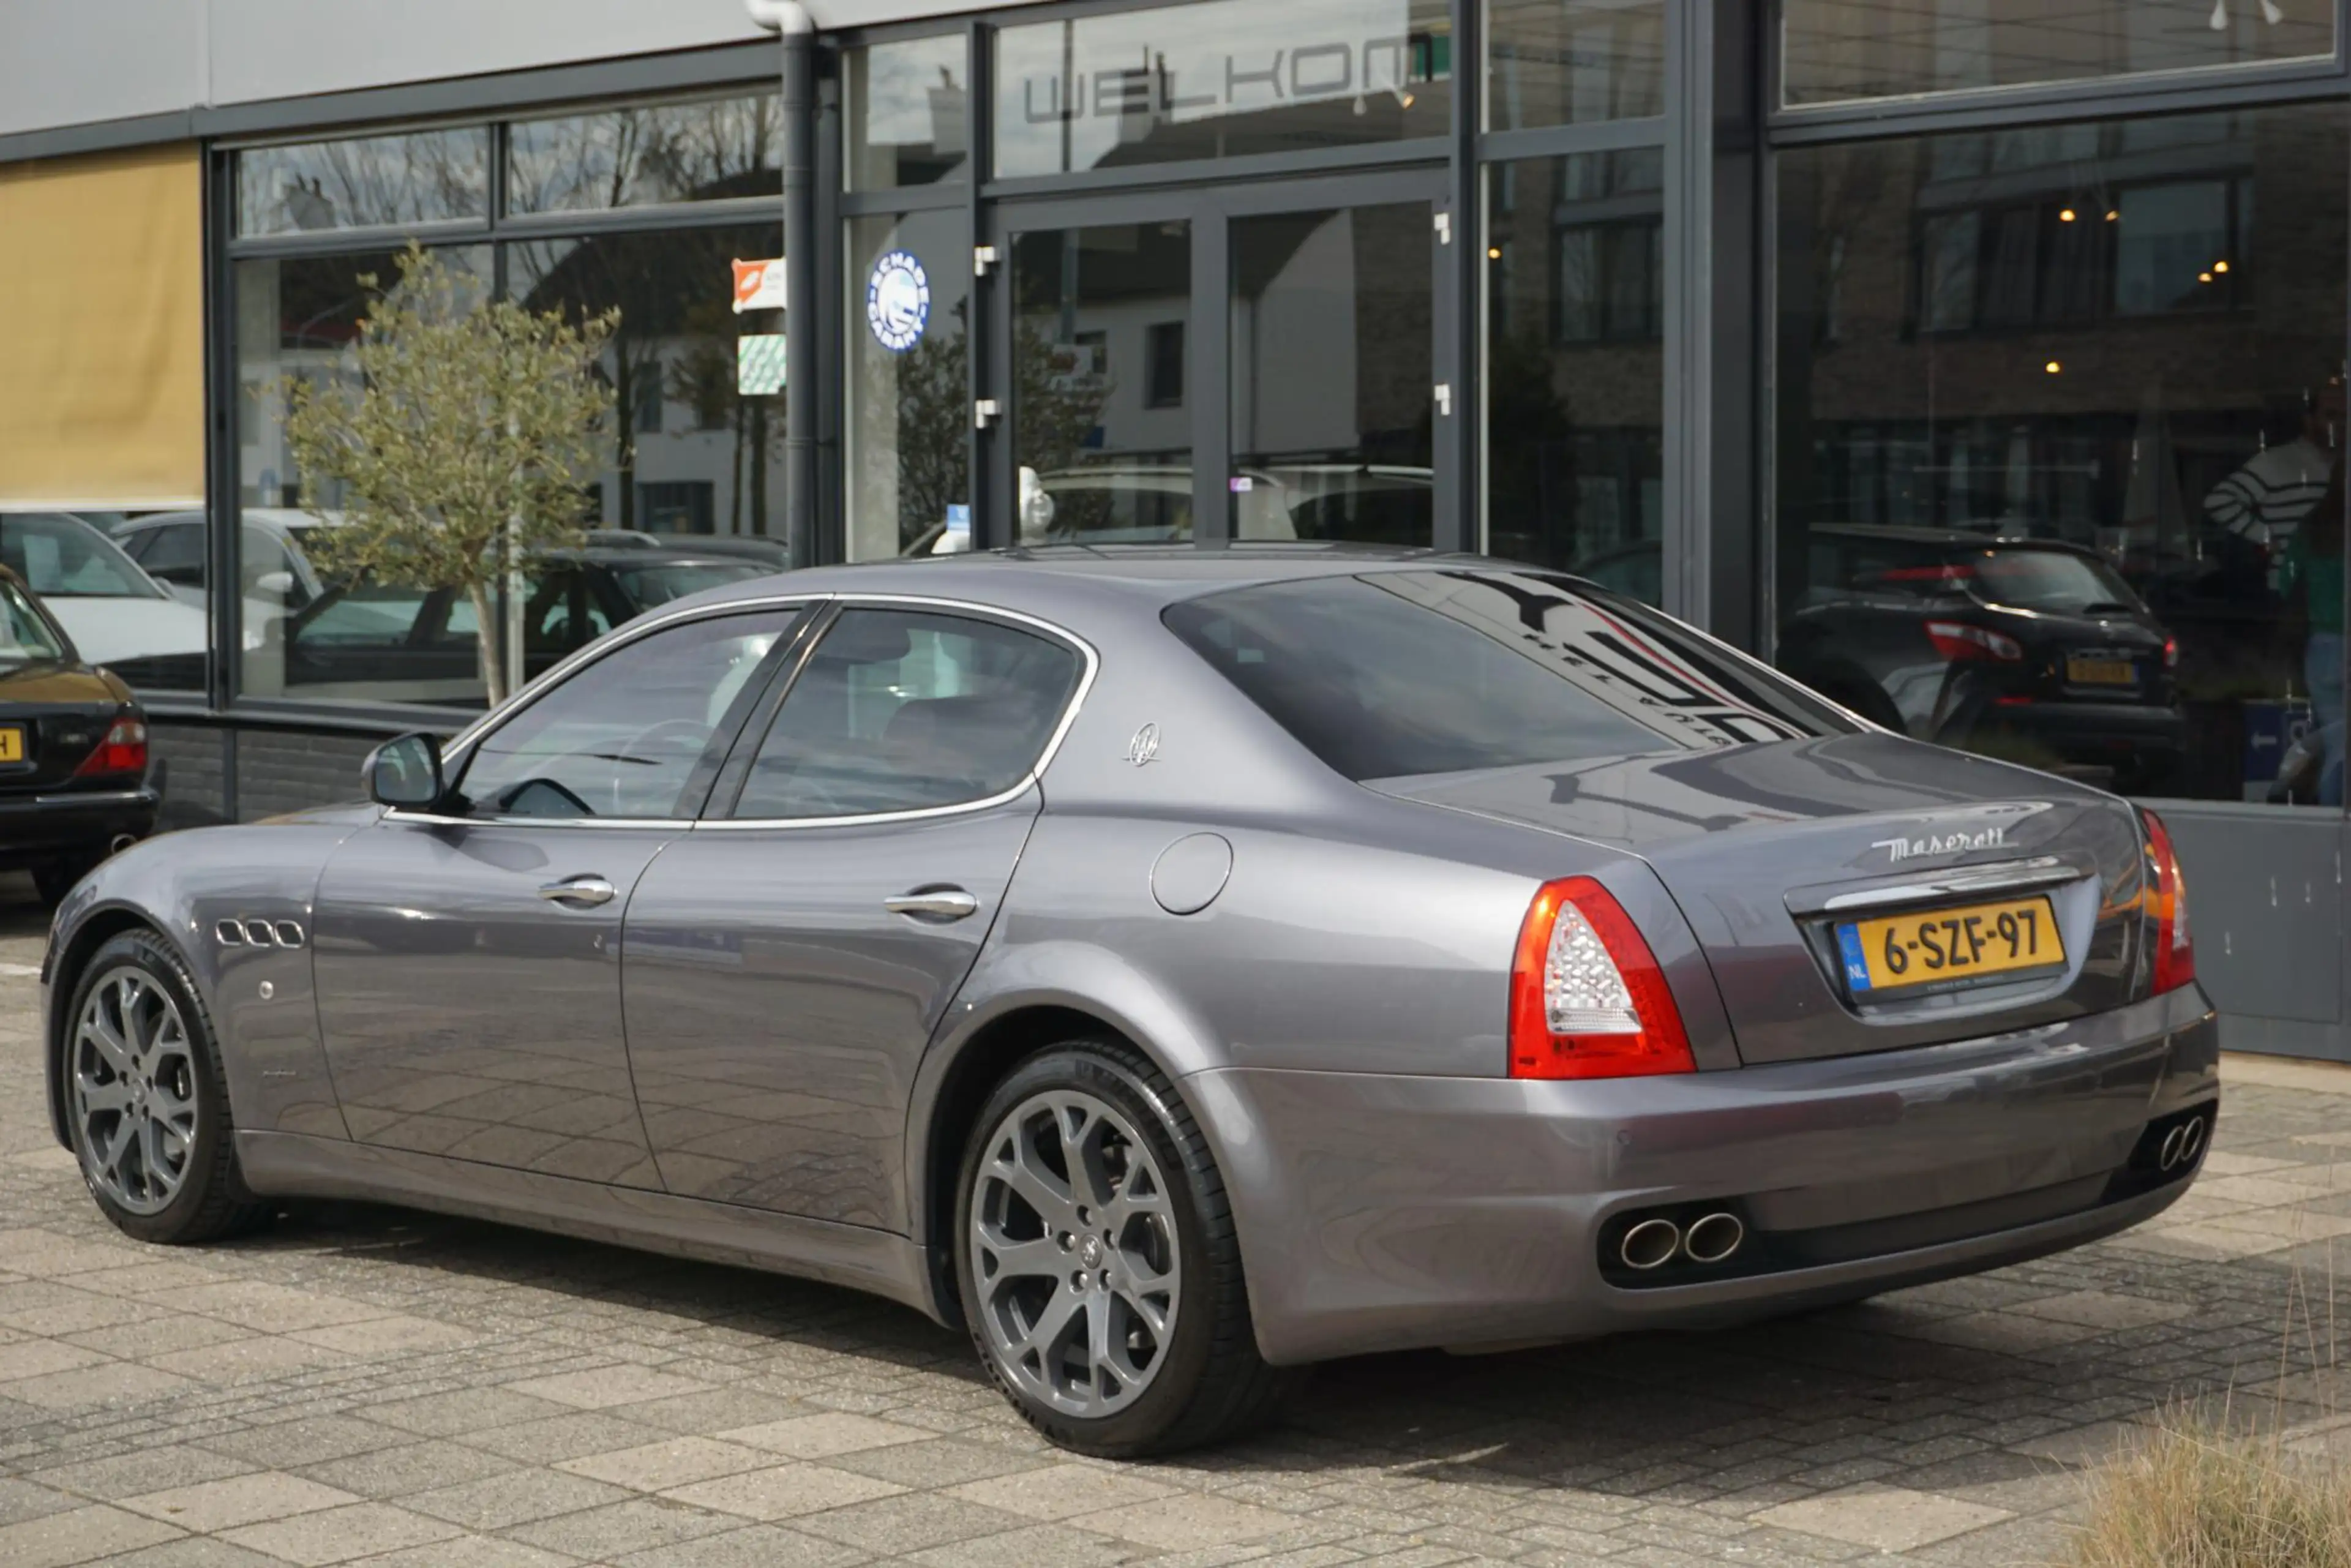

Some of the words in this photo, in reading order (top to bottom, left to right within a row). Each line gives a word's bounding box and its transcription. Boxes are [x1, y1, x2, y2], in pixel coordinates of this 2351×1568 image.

[1025, 33, 1433, 124] WELKOM
[1871, 827, 2019, 863] Maserati
[1884, 909, 2037, 975] 6-SZF-97
[1848, 963, 1867, 980] NL
